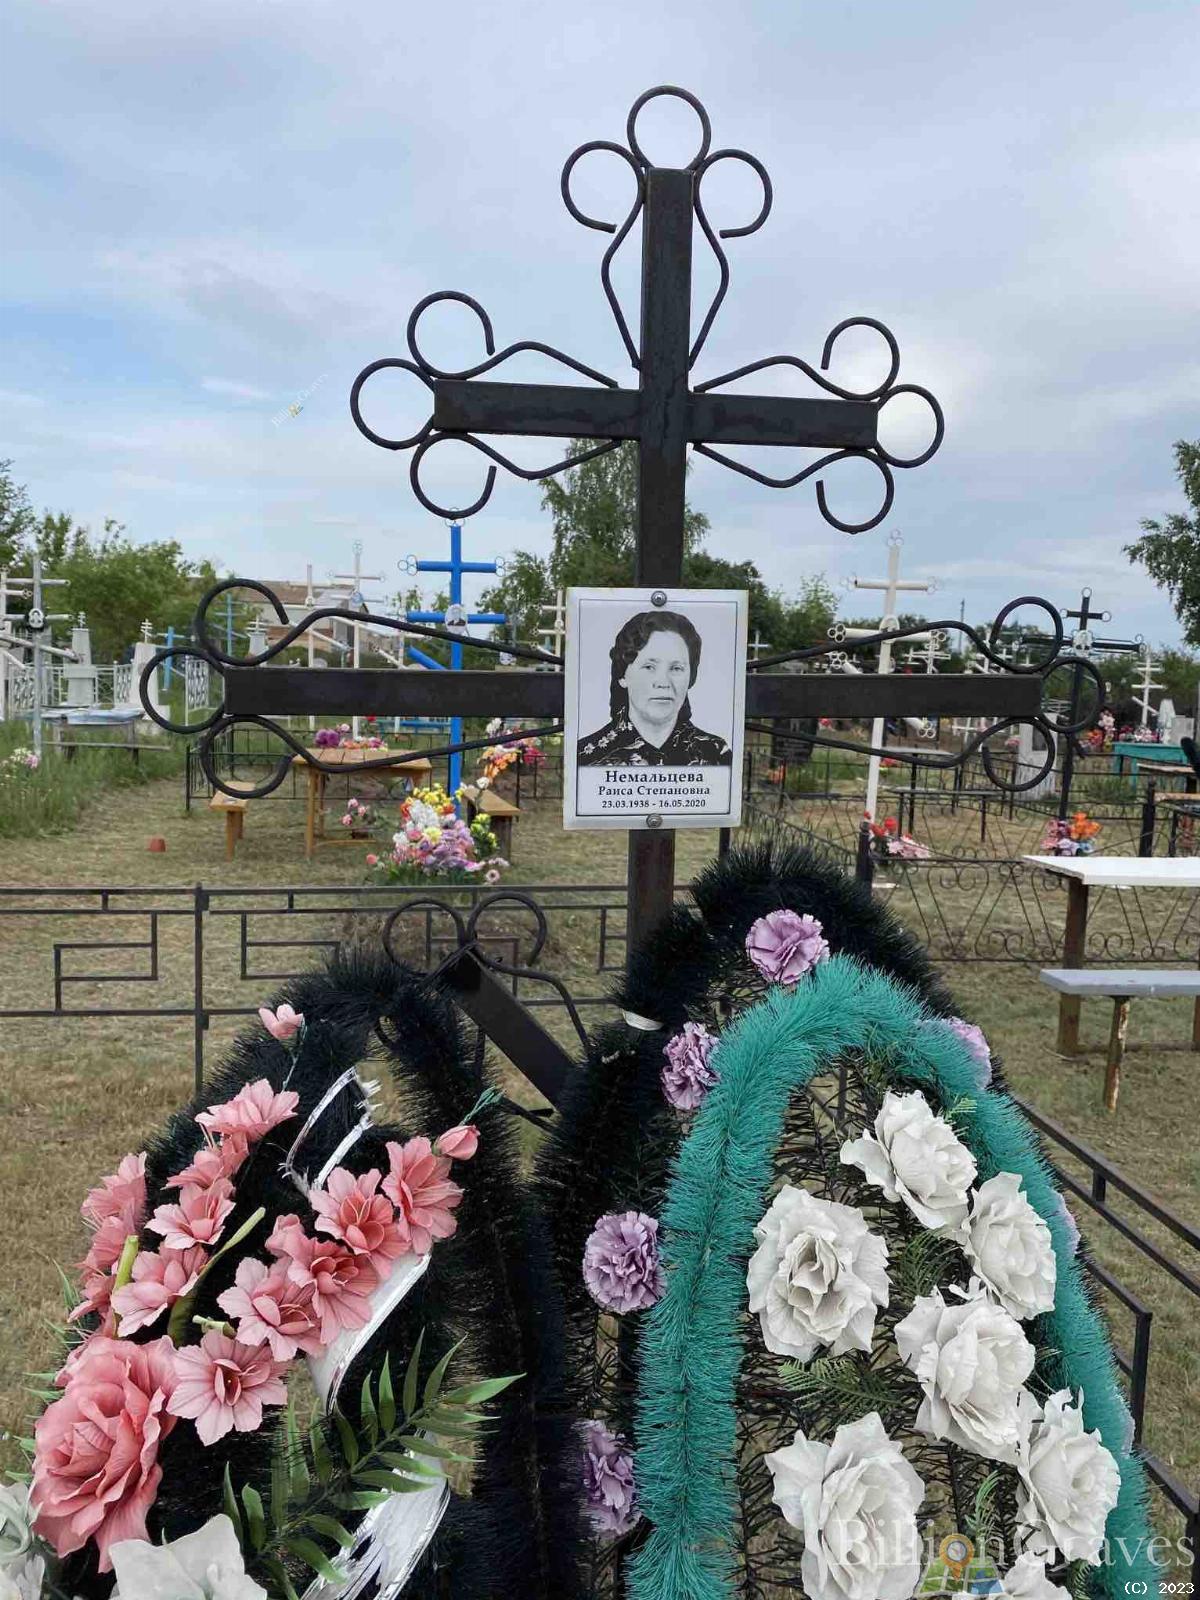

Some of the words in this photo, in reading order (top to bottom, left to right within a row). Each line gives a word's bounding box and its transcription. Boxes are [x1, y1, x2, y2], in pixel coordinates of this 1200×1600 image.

[605, 770, 704, 784] Немальцева
[598, 785, 633, 796] Раиса
[637, 785, 710, 796] Степановна
[602, 799, 650, 809] 23.03.1938
[659, 799, 706, 808] 16.05.2020
